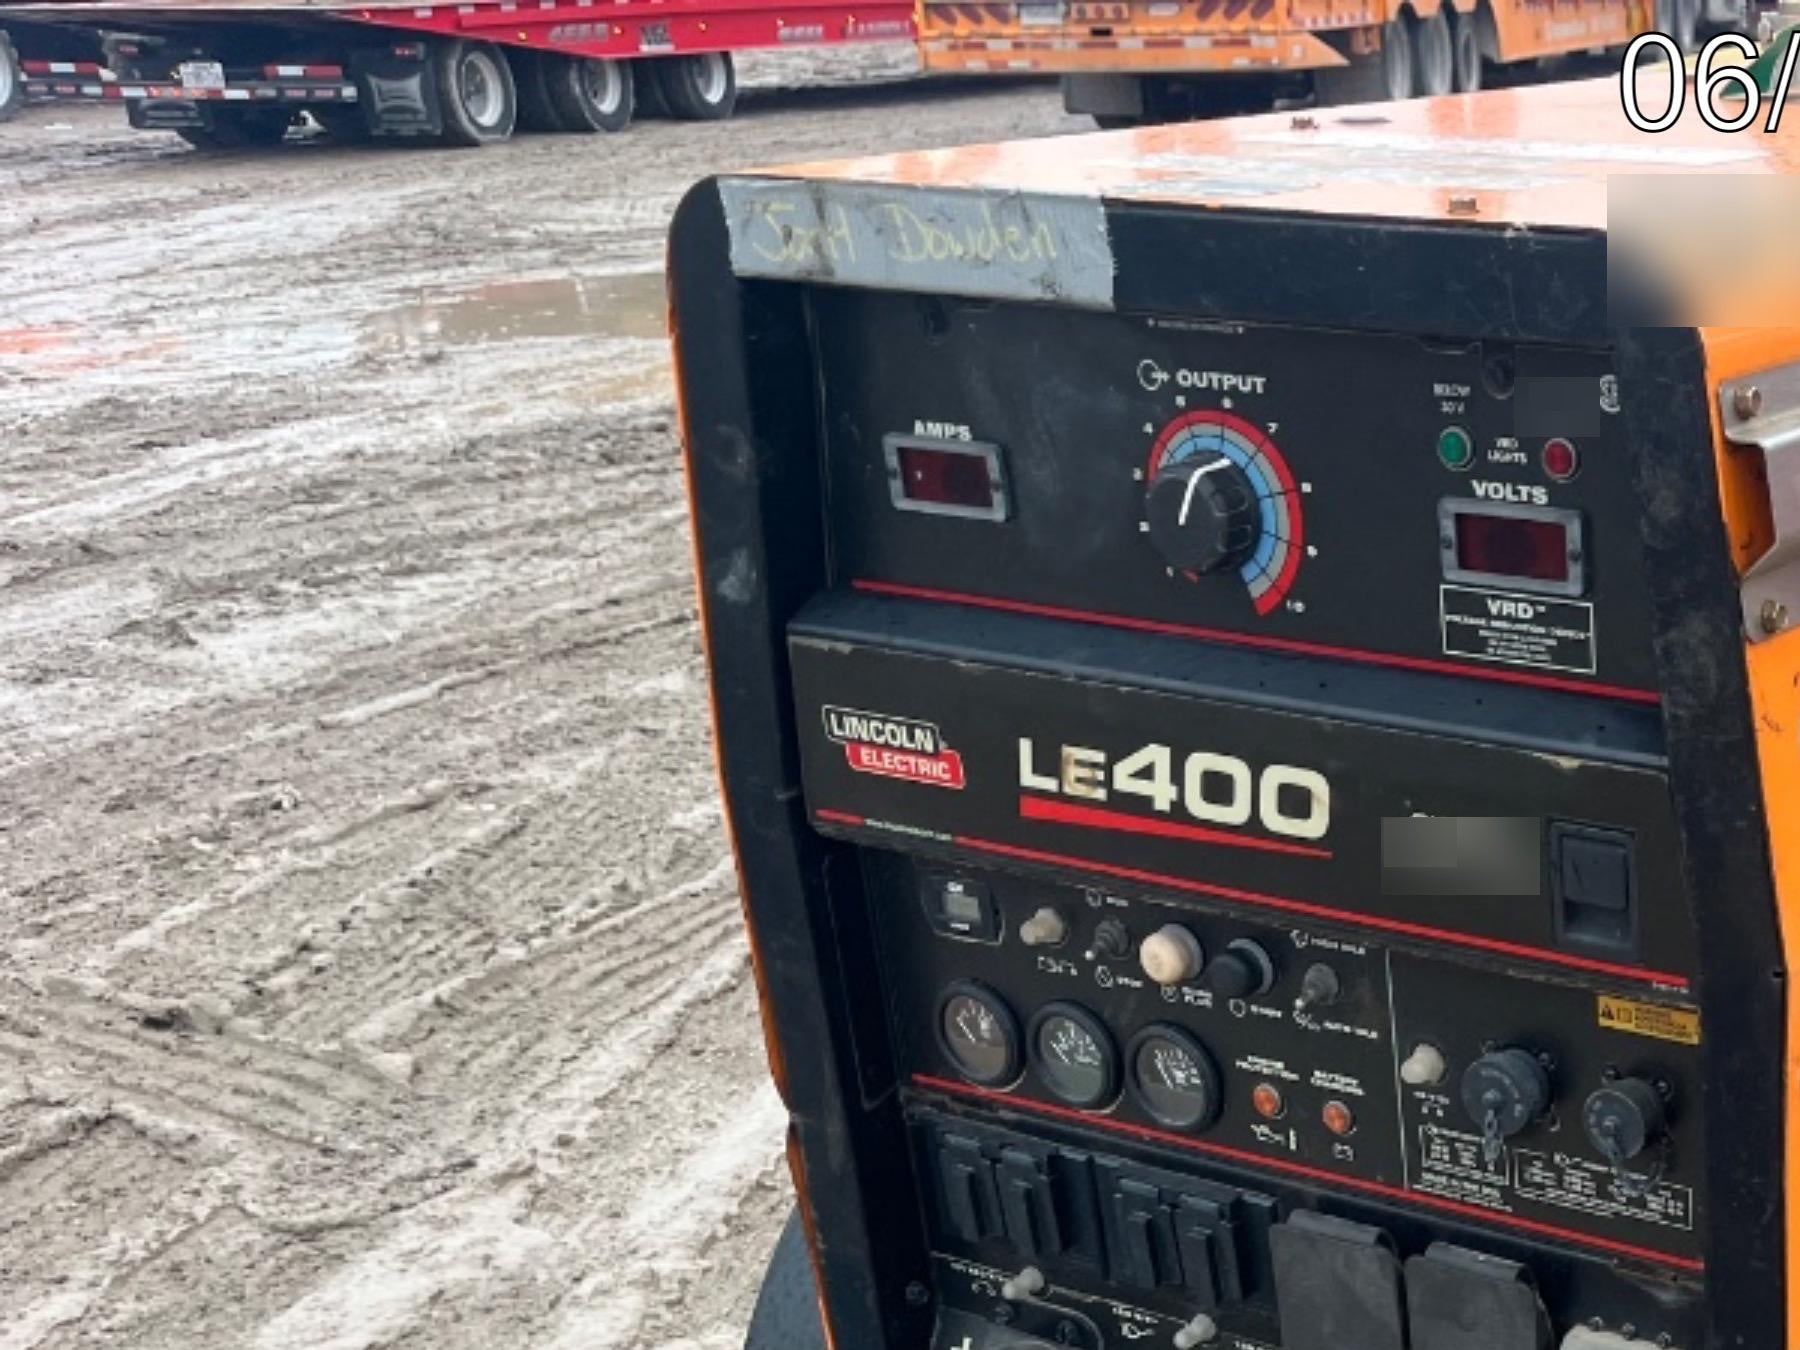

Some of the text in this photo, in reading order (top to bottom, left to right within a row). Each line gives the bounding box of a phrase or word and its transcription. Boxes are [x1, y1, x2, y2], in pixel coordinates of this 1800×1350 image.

[1176, 368, 1267, 394] OUTPUT
[914, 419, 973, 442] AMPS
[1471, 479, 1549, 505] VOLTS
[829, 711, 934, 754] LINCOLN
[860, 747, 952, 781] ELECTRIC
[1018, 736, 1330, 840] LE400
